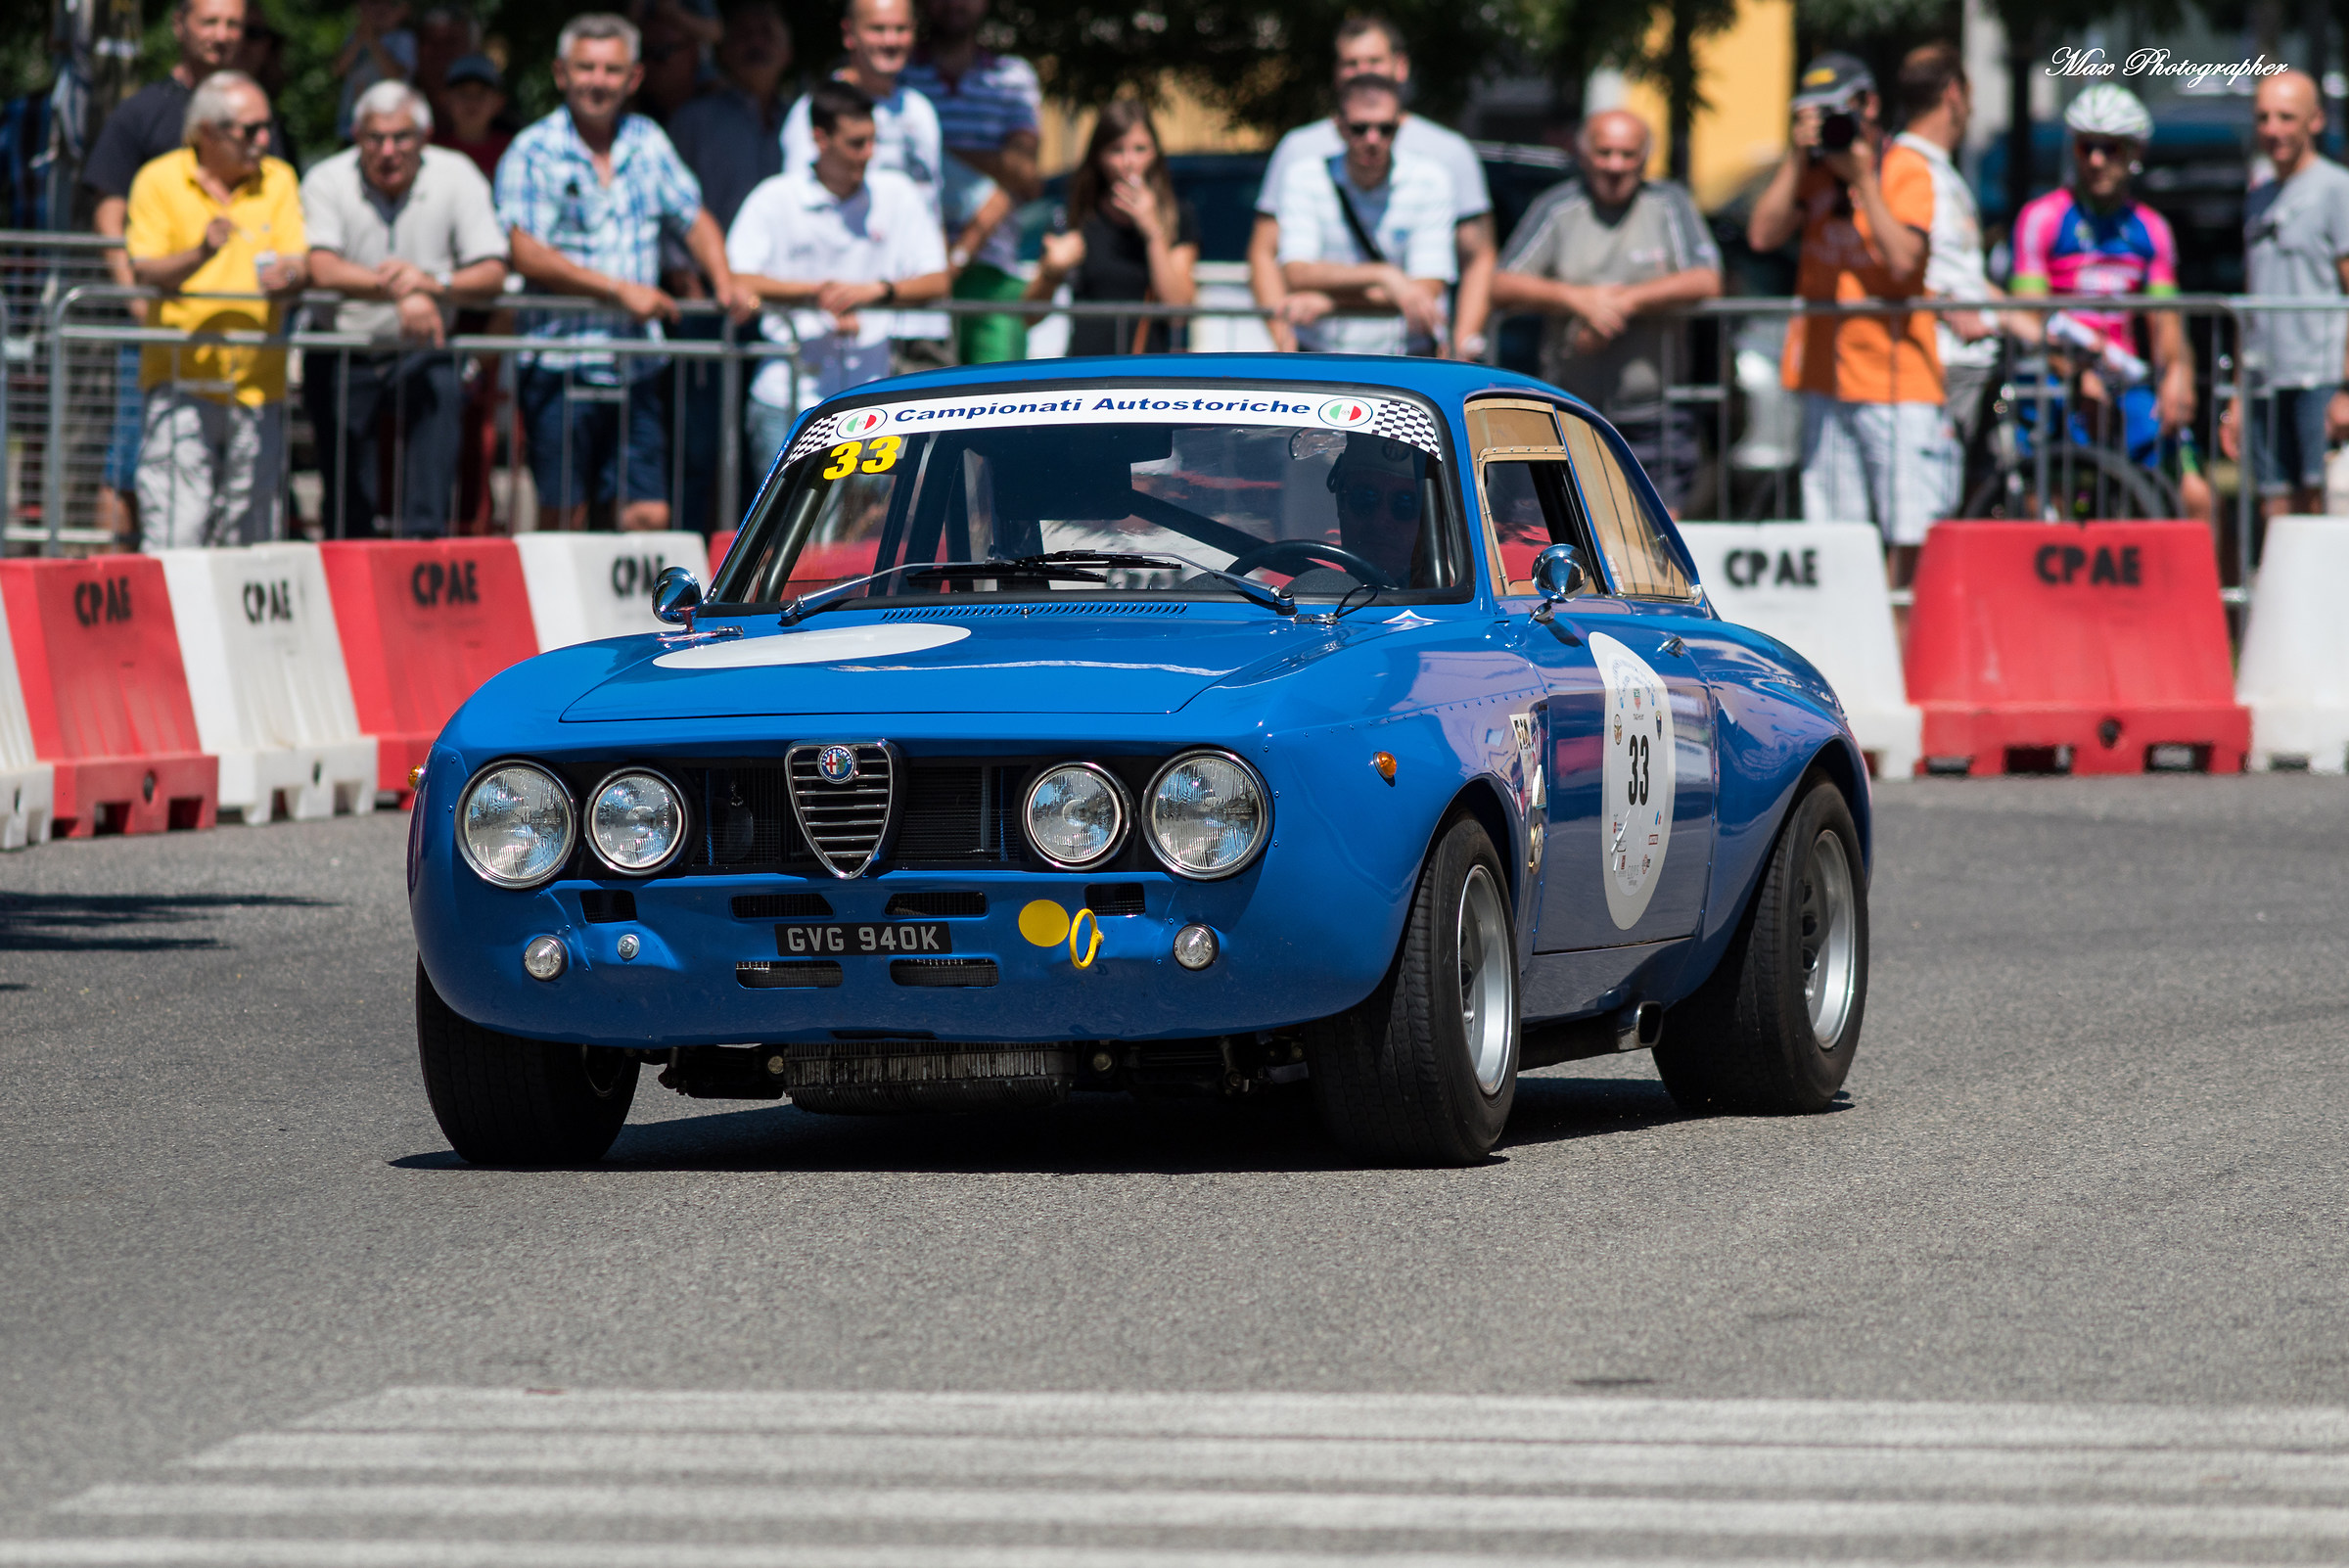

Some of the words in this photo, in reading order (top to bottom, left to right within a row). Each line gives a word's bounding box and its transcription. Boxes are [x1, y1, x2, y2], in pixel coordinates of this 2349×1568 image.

[895, 398, 1082, 423] Campionati
[1091, 397, 1311, 414] Autostoriche
[822, 436, 901, 480] 33
[410, 560, 480, 607] CPAE
[1723, 546, 1819, 588] CPAE
[2034, 543, 2141, 586] CPAE
[74, 576, 132, 627] CPAE
[242, 578, 293, 624] CPAE
[1628, 734, 1649, 806] 33
[788, 927, 844, 951] GVG
[859, 926, 940, 950] 940K
